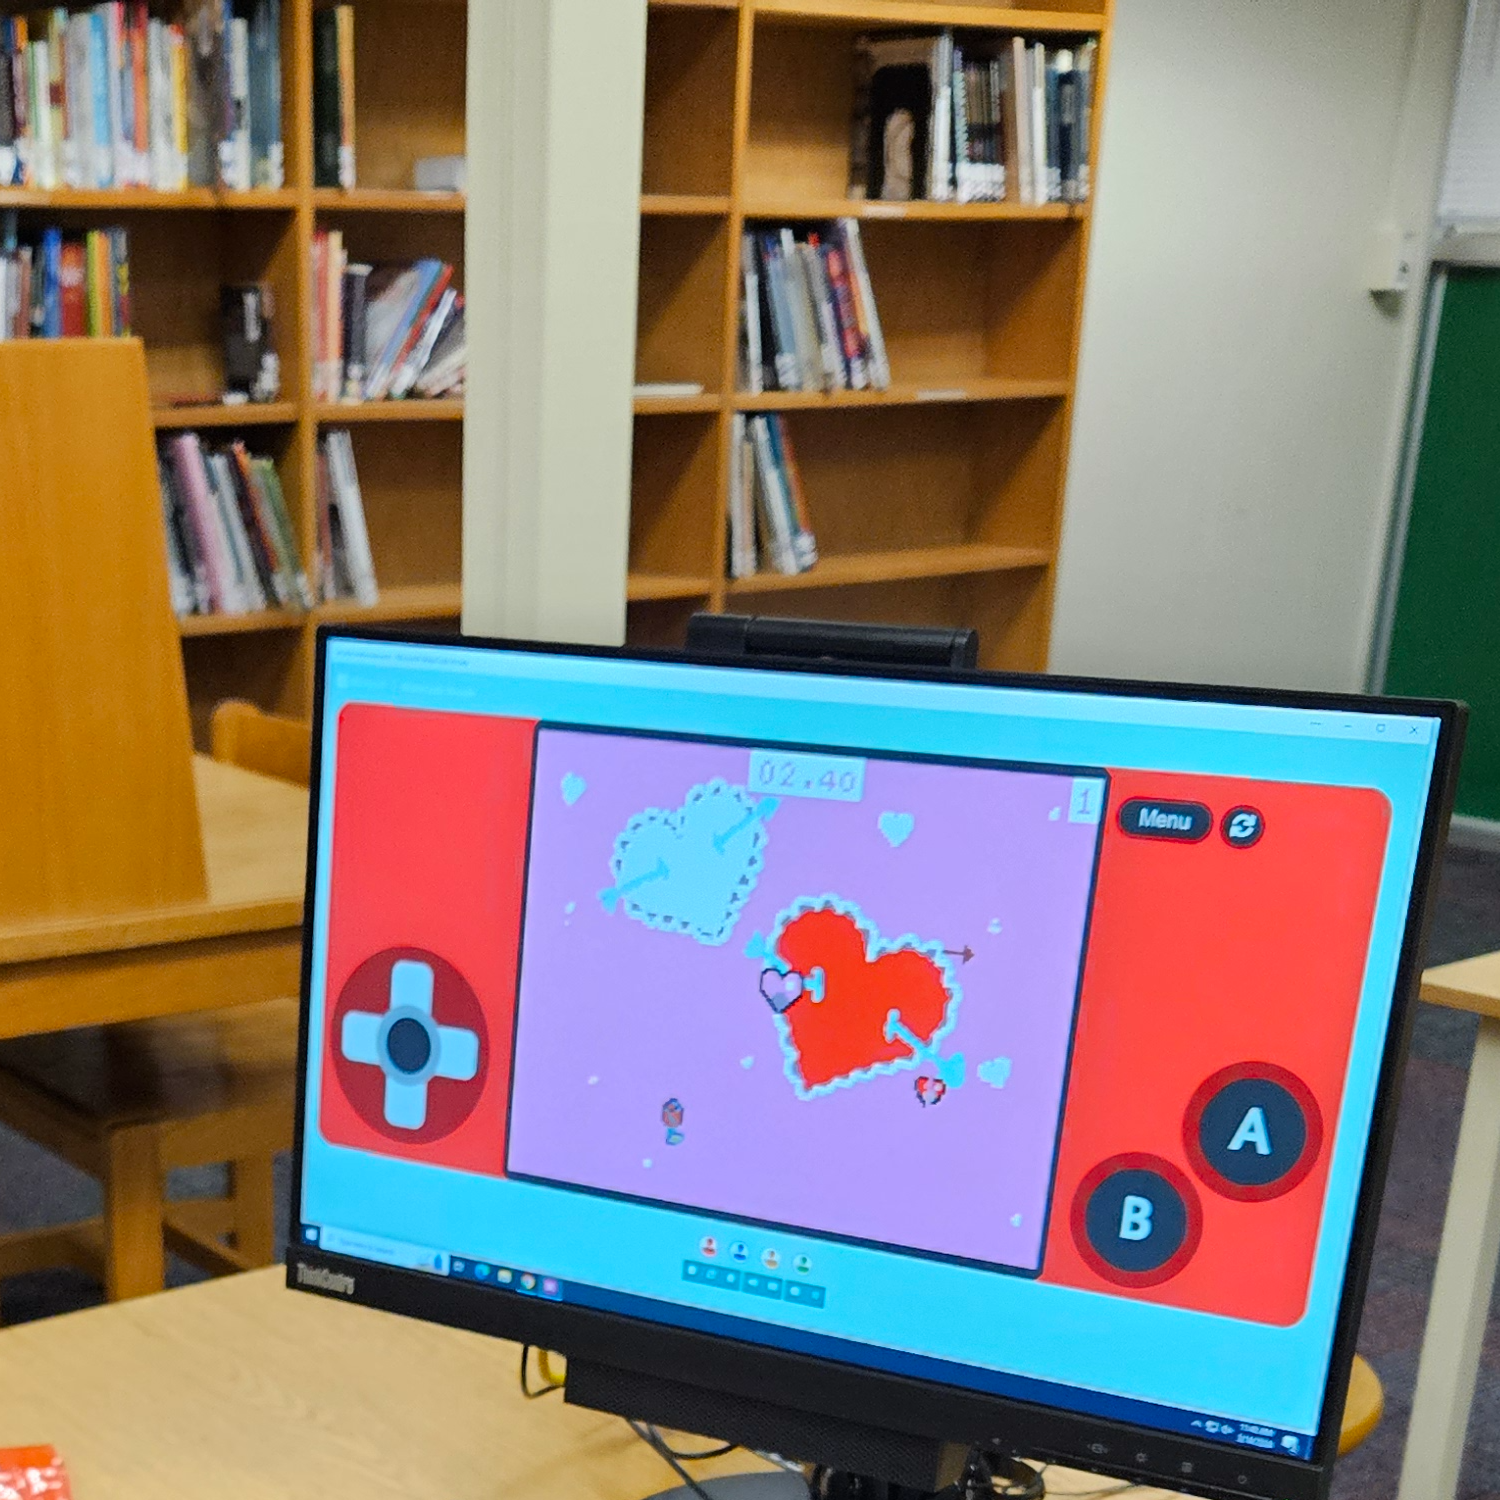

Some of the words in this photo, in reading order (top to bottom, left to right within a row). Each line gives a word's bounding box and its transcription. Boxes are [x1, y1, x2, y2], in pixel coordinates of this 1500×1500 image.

[1077, 787, 1090, 815] 1
[1138, 807, 1193, 831] Menu
[1227, 1106, 1273, 1156] A
[1118, 1195, 1154, 1241] B
